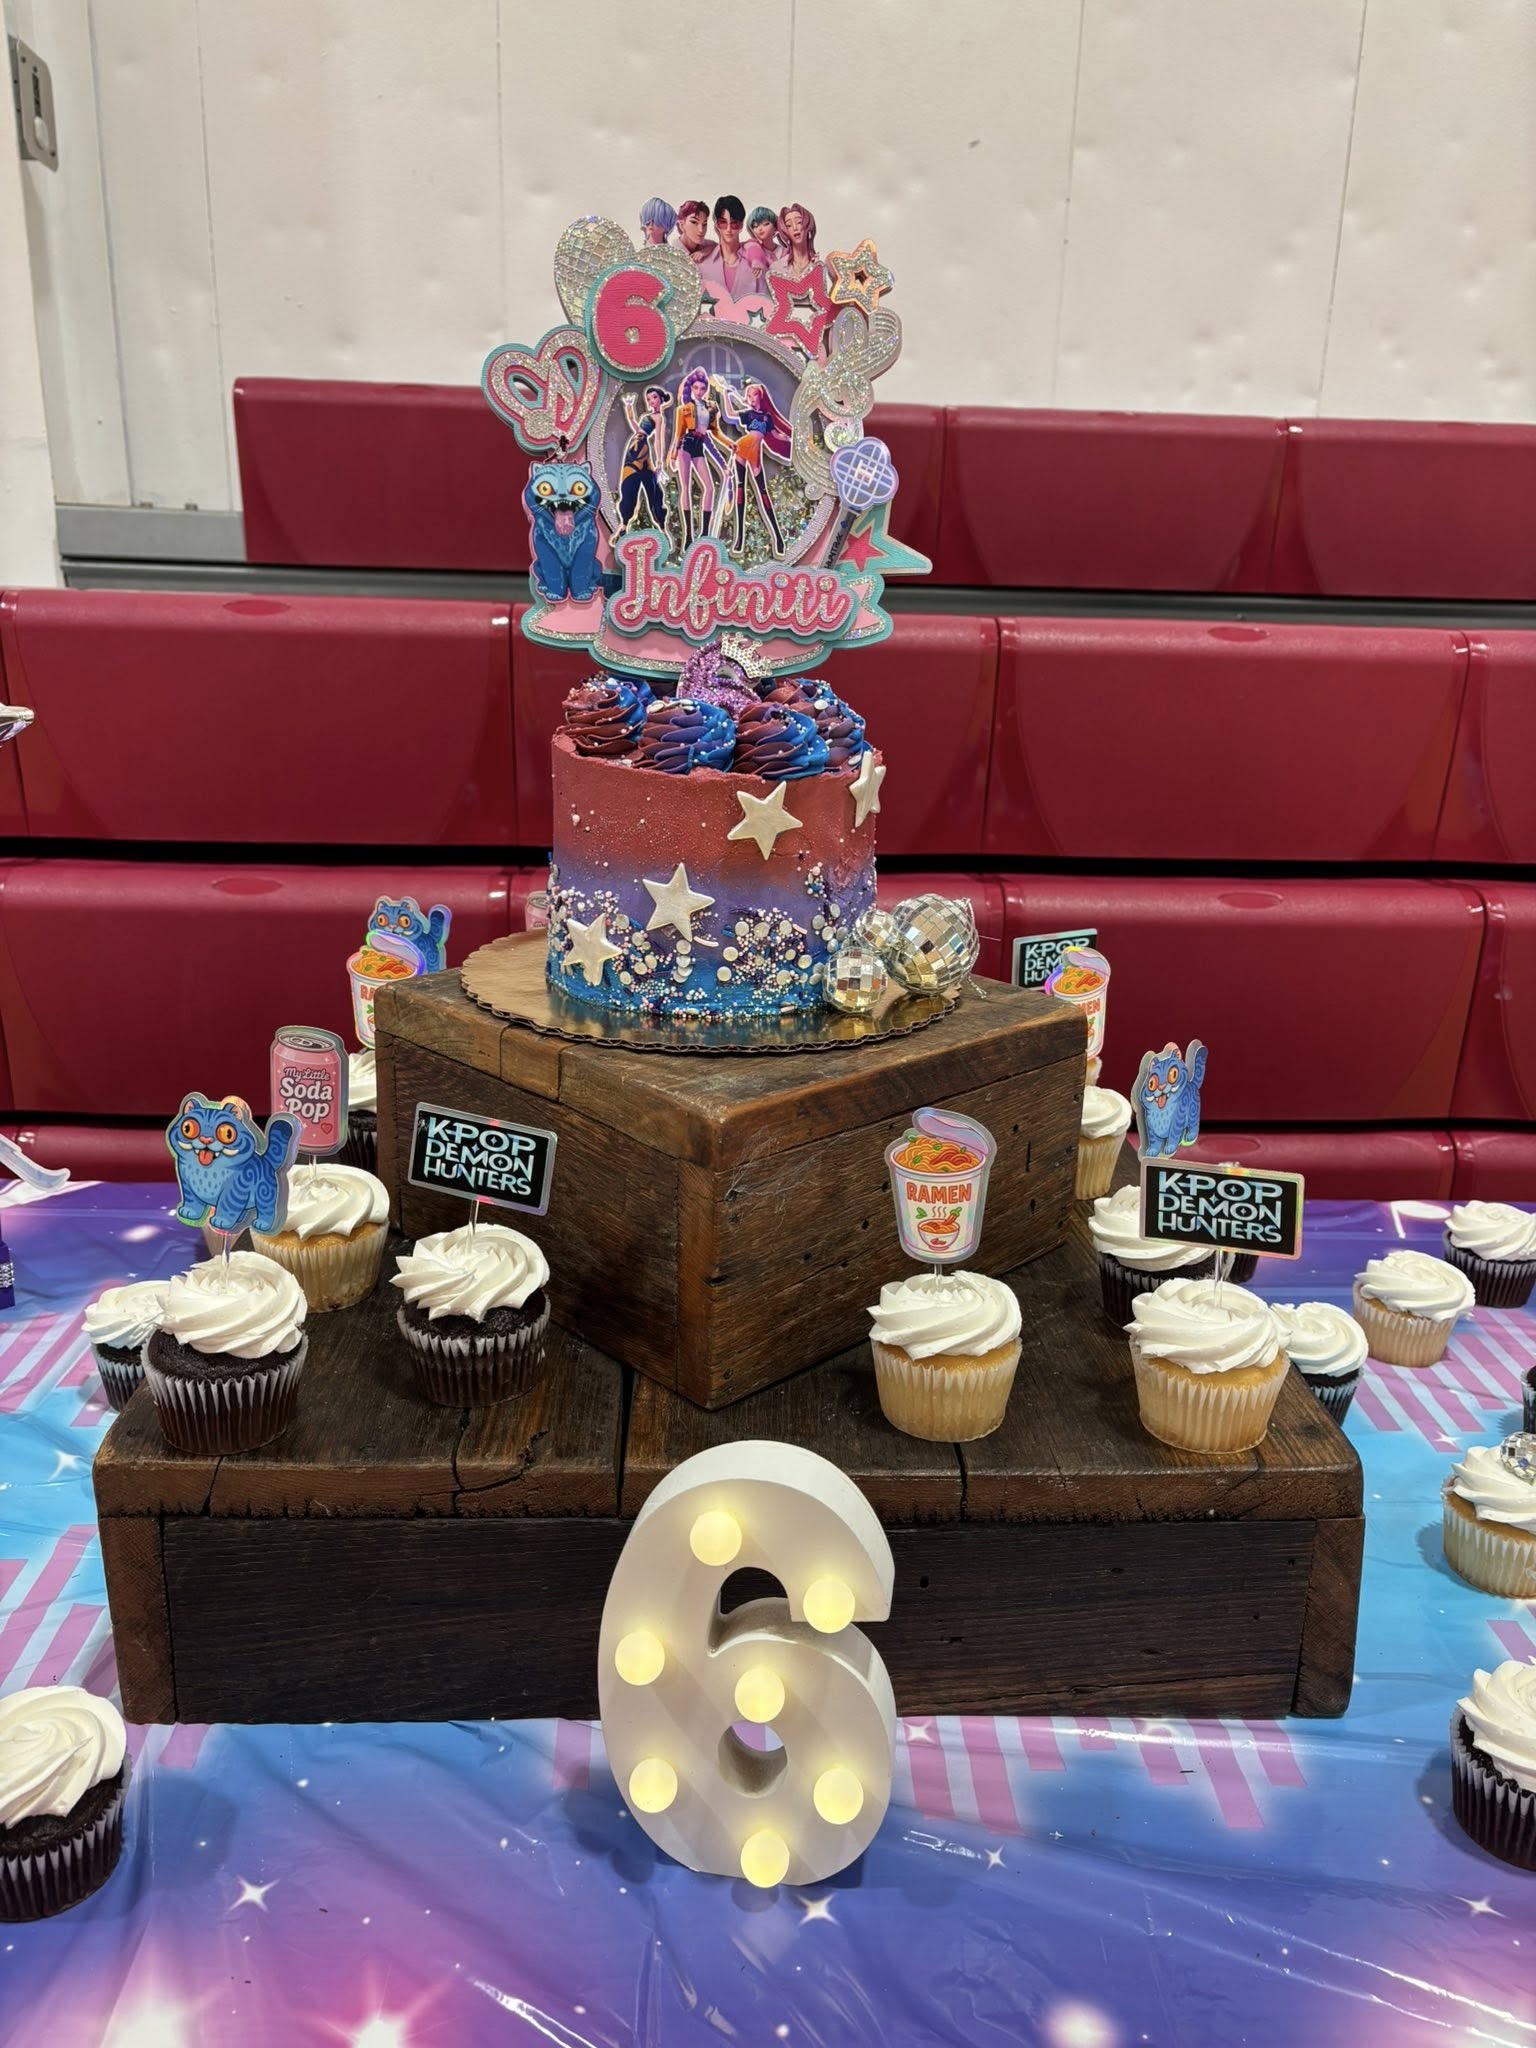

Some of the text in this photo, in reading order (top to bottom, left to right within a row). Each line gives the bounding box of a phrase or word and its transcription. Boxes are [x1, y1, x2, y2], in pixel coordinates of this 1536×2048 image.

[592, 265, 672, 374] 6
[617, 539, 848, 631] Infiniti
[279, 1076, 334, 1101] Soda
[284, 1067, 331, 1082] My Little
[285, 1098, 331, 1124] Pop
[423, 1156, 532, 1196] HUNTERS
[425, 1138, 535, 1183] DEMON
[906, 1181, 973, 1205] RAMEN
[1158, 1192, 1282, 1229] DEMON
[1157, 1211, 1283, 1244] HUNTERS
[598, 1439, 897, 1888] 6
